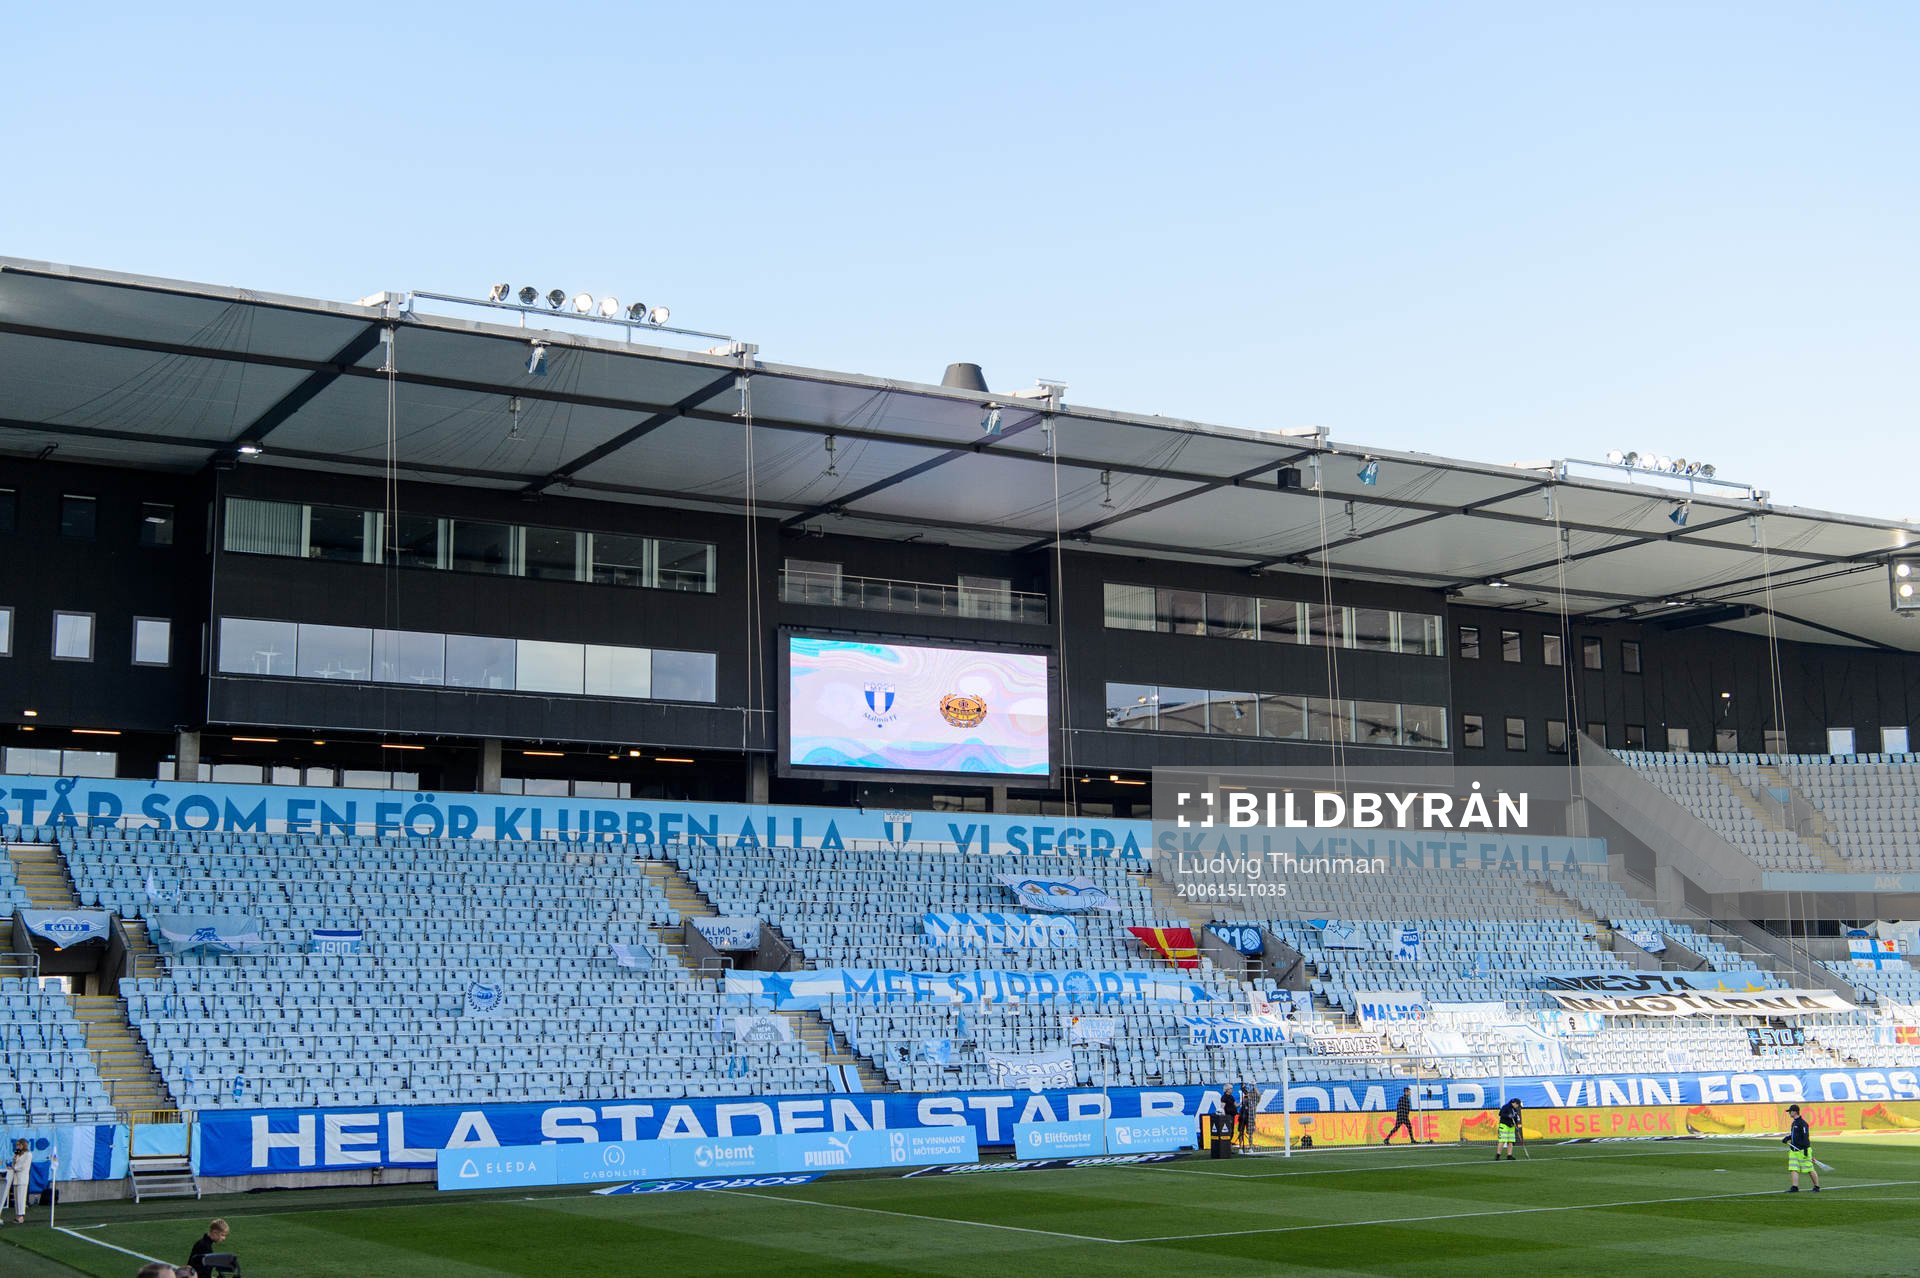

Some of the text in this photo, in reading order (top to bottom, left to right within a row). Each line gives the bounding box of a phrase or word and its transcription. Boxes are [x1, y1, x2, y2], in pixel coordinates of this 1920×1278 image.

[141, 794, 267, 833] SOM
[287, 800, 356, 836] EN
[376, 793, 479, 839] FÖR
[495, 806, 719, 847] KLUBBEN
[947, 823, 989, 855] VI
[1875, 877, 1902, 890] AAK
[947, 970, 1148, 1005] SUPPORT
[251, 1111, 501, 1168] HELA
[541, 1099, 886, 1146] STADEN
[918, 1077, 1112, 1142] STÅR
[1543, 1078, 1679, 1107] VINN
[1820, 1071, 1920, 1101] OSS
[1548, 1111, 1672, 1135] RISE PACK
[1045, 1131, 1091, 1143] Elitfönster
[1133, 1125, 1188, 1137] exakta
[912, 1135, 966, 1146] EN VINNANDE
[714, 1144, 755, 1160] bemt
[805, 1149, 845, 1165] PUMA
[913, 1145, 961, 1156] MÖTESPLATS
[486, 1160, 537, 1174] ELEDA
[583, 1168, 647, 1179] CABONLINE
[694, 1175, 811, 1189] OBOS
